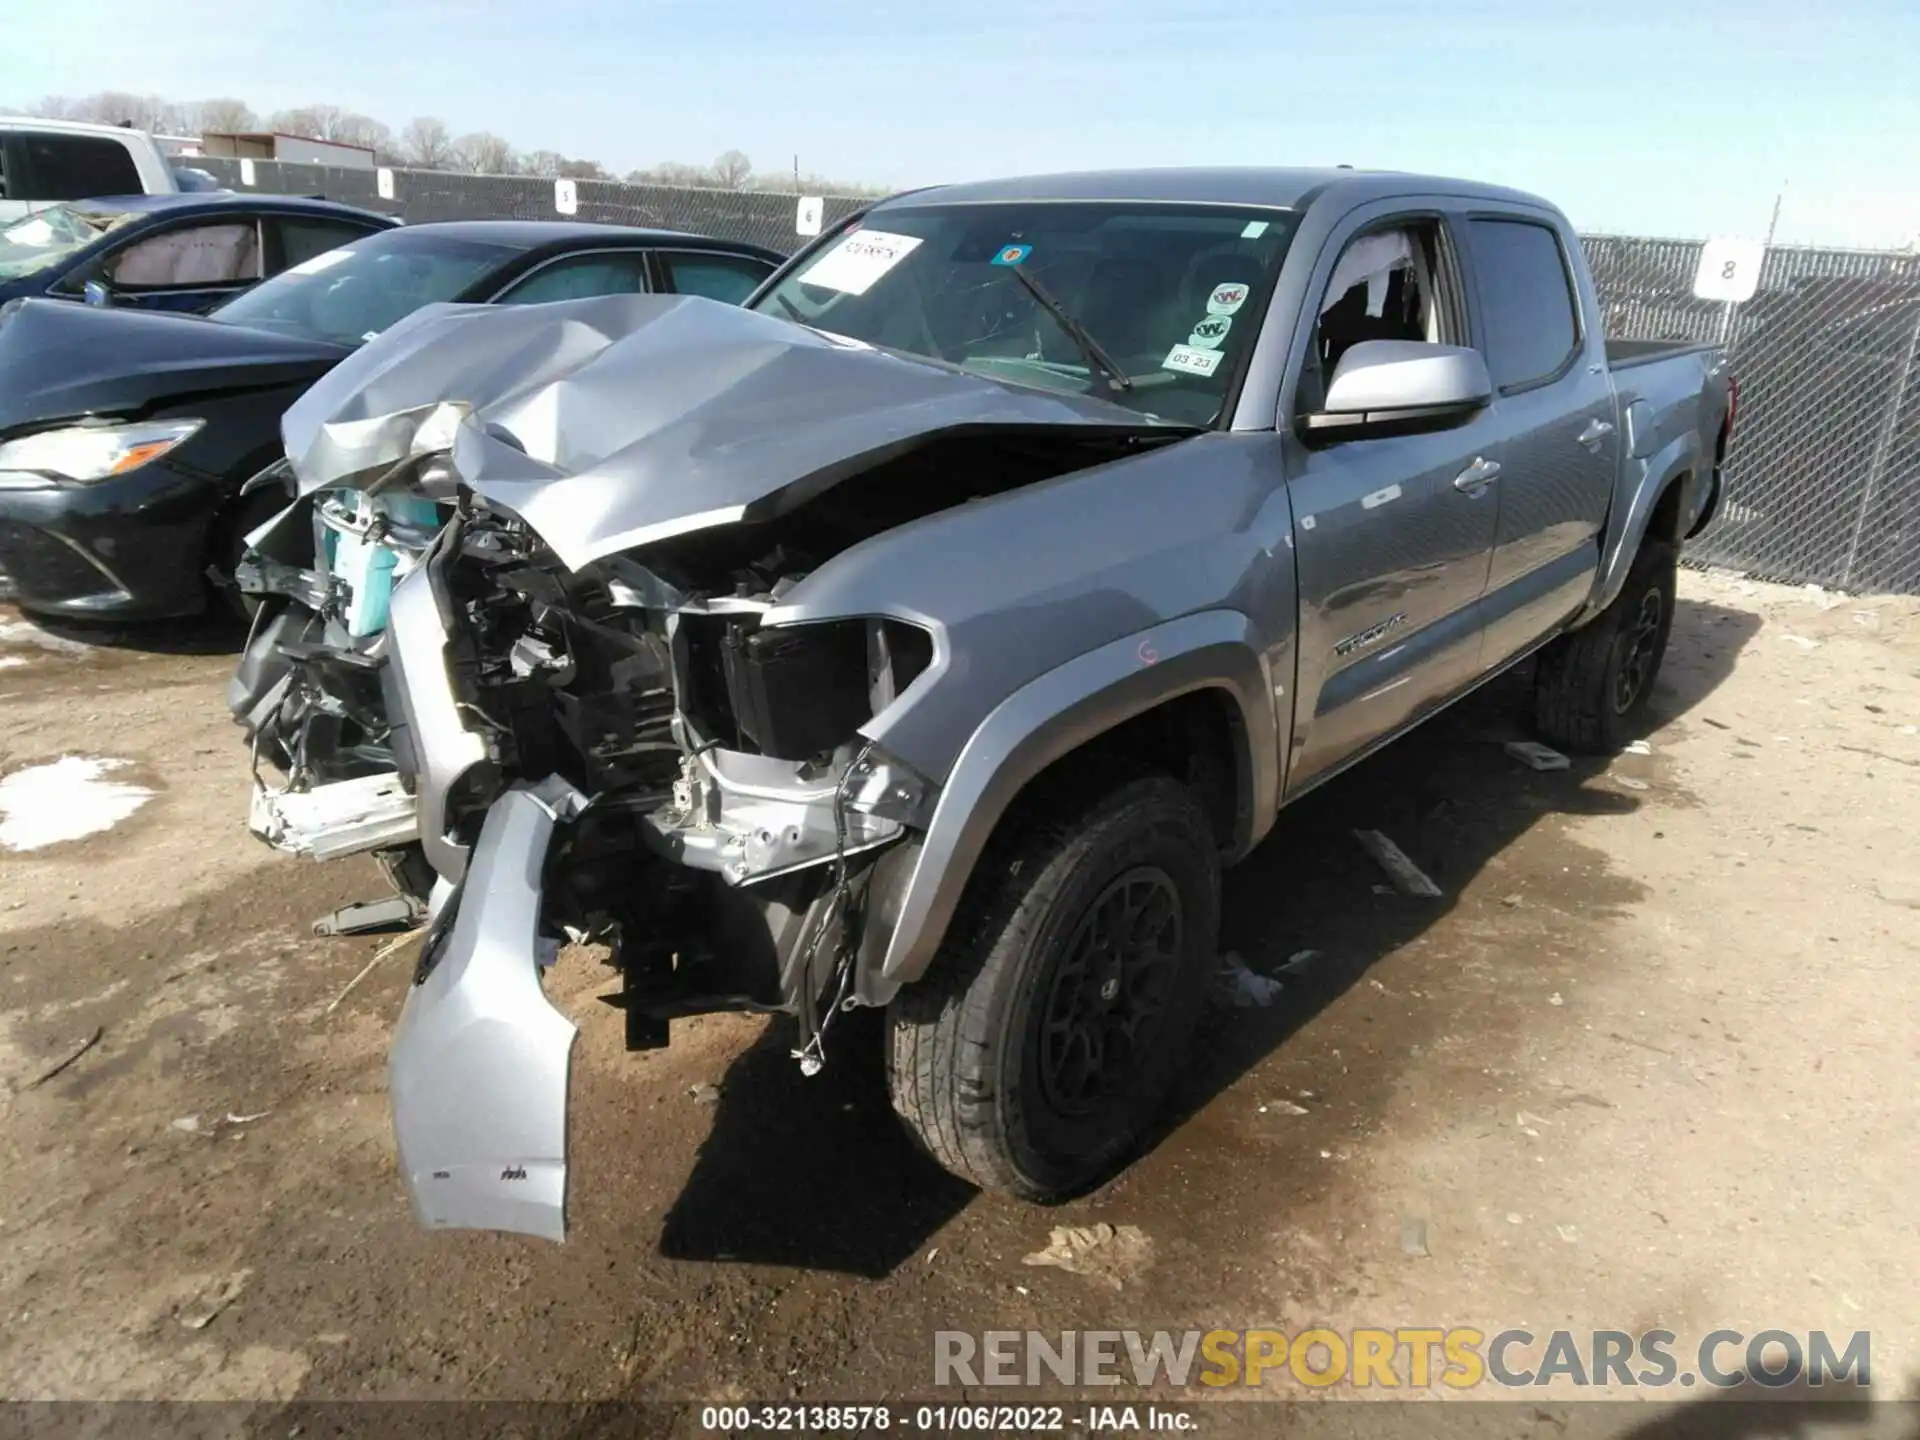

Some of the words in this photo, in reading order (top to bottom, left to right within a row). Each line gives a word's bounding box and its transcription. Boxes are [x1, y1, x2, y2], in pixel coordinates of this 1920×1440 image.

[1721, 260, 1737, 280] 8
[1173, 353, 1190, 365] 03
[1193, 356, 1212, 369] 23
